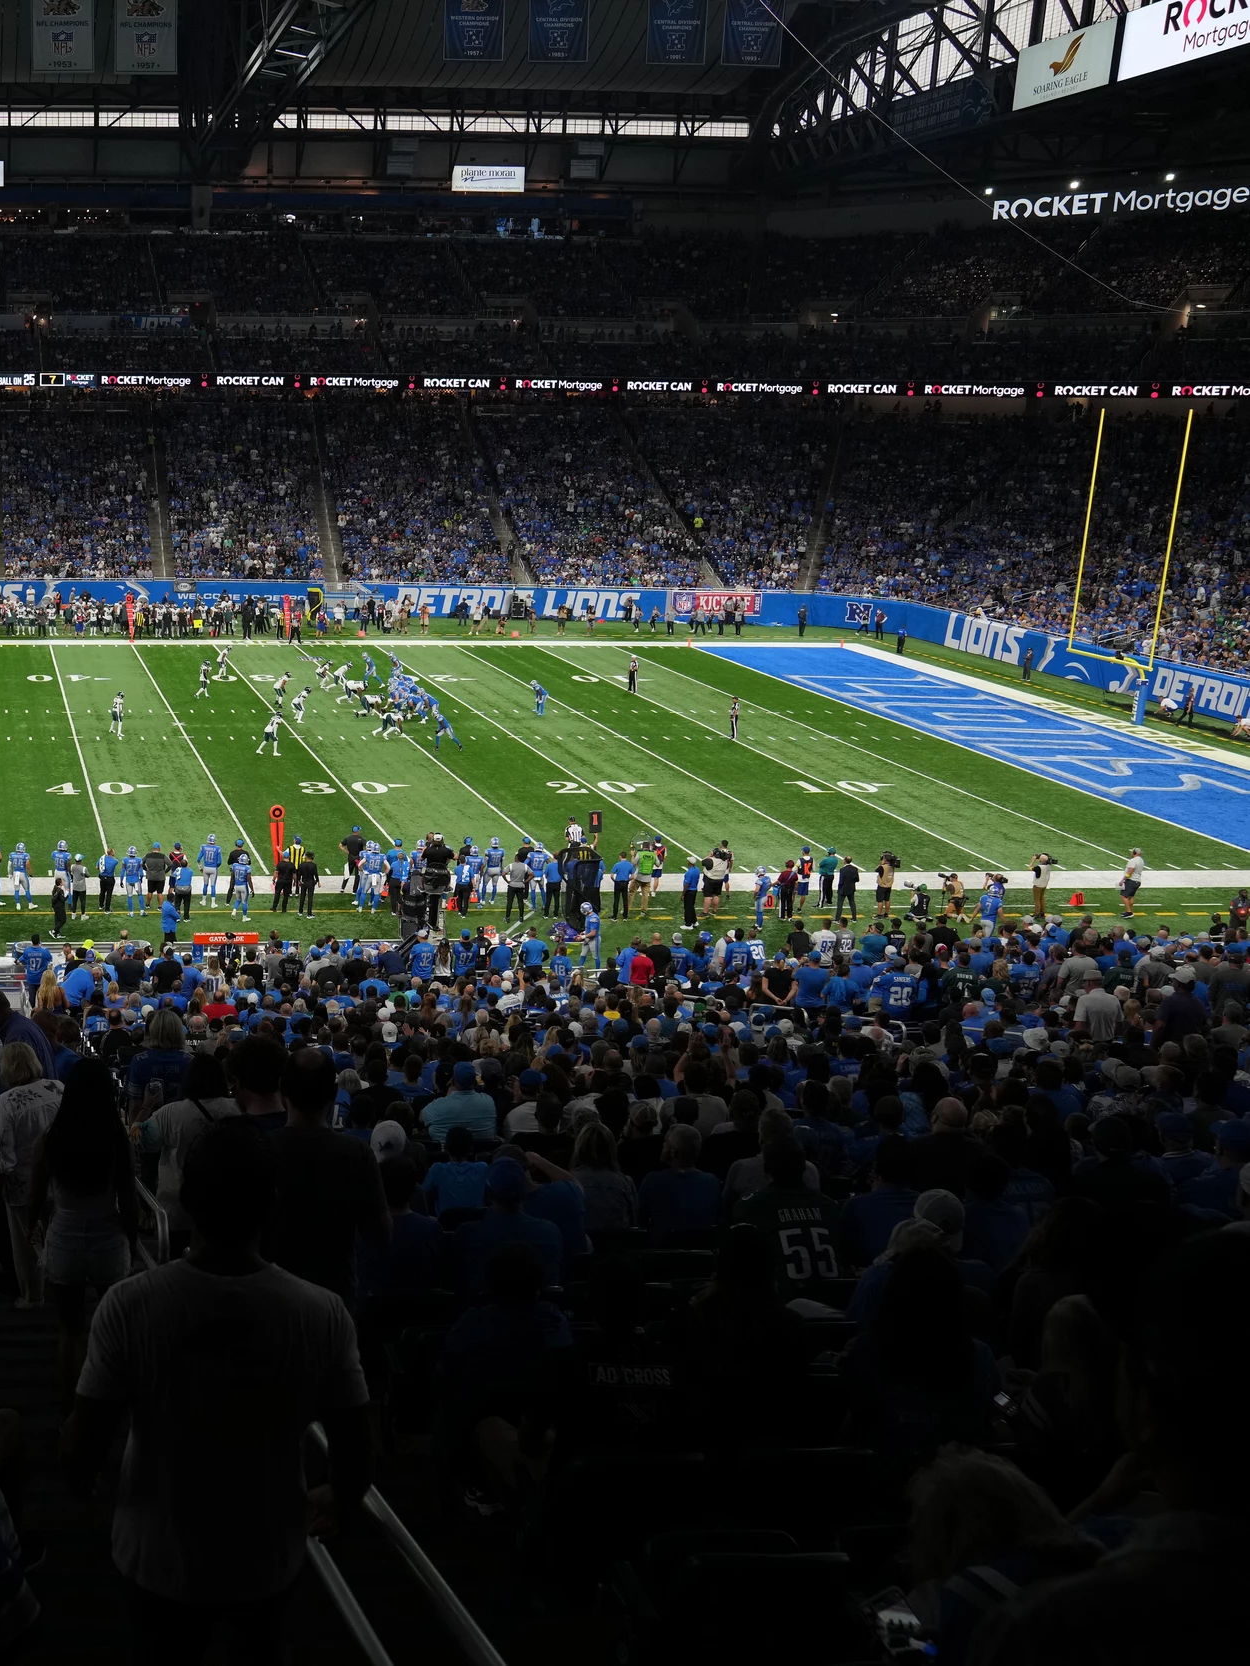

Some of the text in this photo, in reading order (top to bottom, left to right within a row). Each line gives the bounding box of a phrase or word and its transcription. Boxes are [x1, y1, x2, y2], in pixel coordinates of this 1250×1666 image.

[1183, 20, 1250, 52] Mortgag
[1032, 72, 1088, 96] SOARING EAGLE
[461, 168, 487, 177] plante
[992, 187, 1250, 220] ROCKET Mortgage
[12, 377, 22, 385] ON
[24, 374, 35, 385] 25
[49, 376, 56, 384] 7
[101, 376, 191, 385] ROCKET Mortgage
[217, 376, 284, 386] ROCKET CAN
[310, 377, 398, 387] ROCKET Mortgage
[424, 378, 490, 388] ROCKET CAN
[516, 380, 602, 390] ROCKET Mortgage
[627, 382, 692, 391] ROCKET CAN
[717, 383, 802, 394] ROCKET Mortgage
[828, 384, 897, 393] ROCKET CAN
[924, 385, 1024, 397] ROCKET Mortgage
[1055, 386, 1138, 395] ROCKET CAN
[1172, 386, 1230, 396] ROCKET
[544, 590, 641, 618] LIONS
[944, 612, 1026, 665] LIONS
[1152, 667, 1250, 717] DETROI
[46, 781, 135, 796] 40
[298, 781, 387, 796] 30
[546, 780, 636, 794] 20
[592, 814, 598, 825] 1
[804, 863, 811, 874] K
[985, 903, 991, 914] 3
[820, 940, 832, 953] 97
[840, 940, 852, 952] 32
[29, 958, 41, 968] 97
[421, 952, 431, 967] 32
[554, 965, 566, 976] 18
[889, 986, 913, 1006] 20
[152, 1064, 180, 1074] WILSON
[778, 1207, 823, 1223] GRAHAM
[779, 1227, 839, 1281] 55
